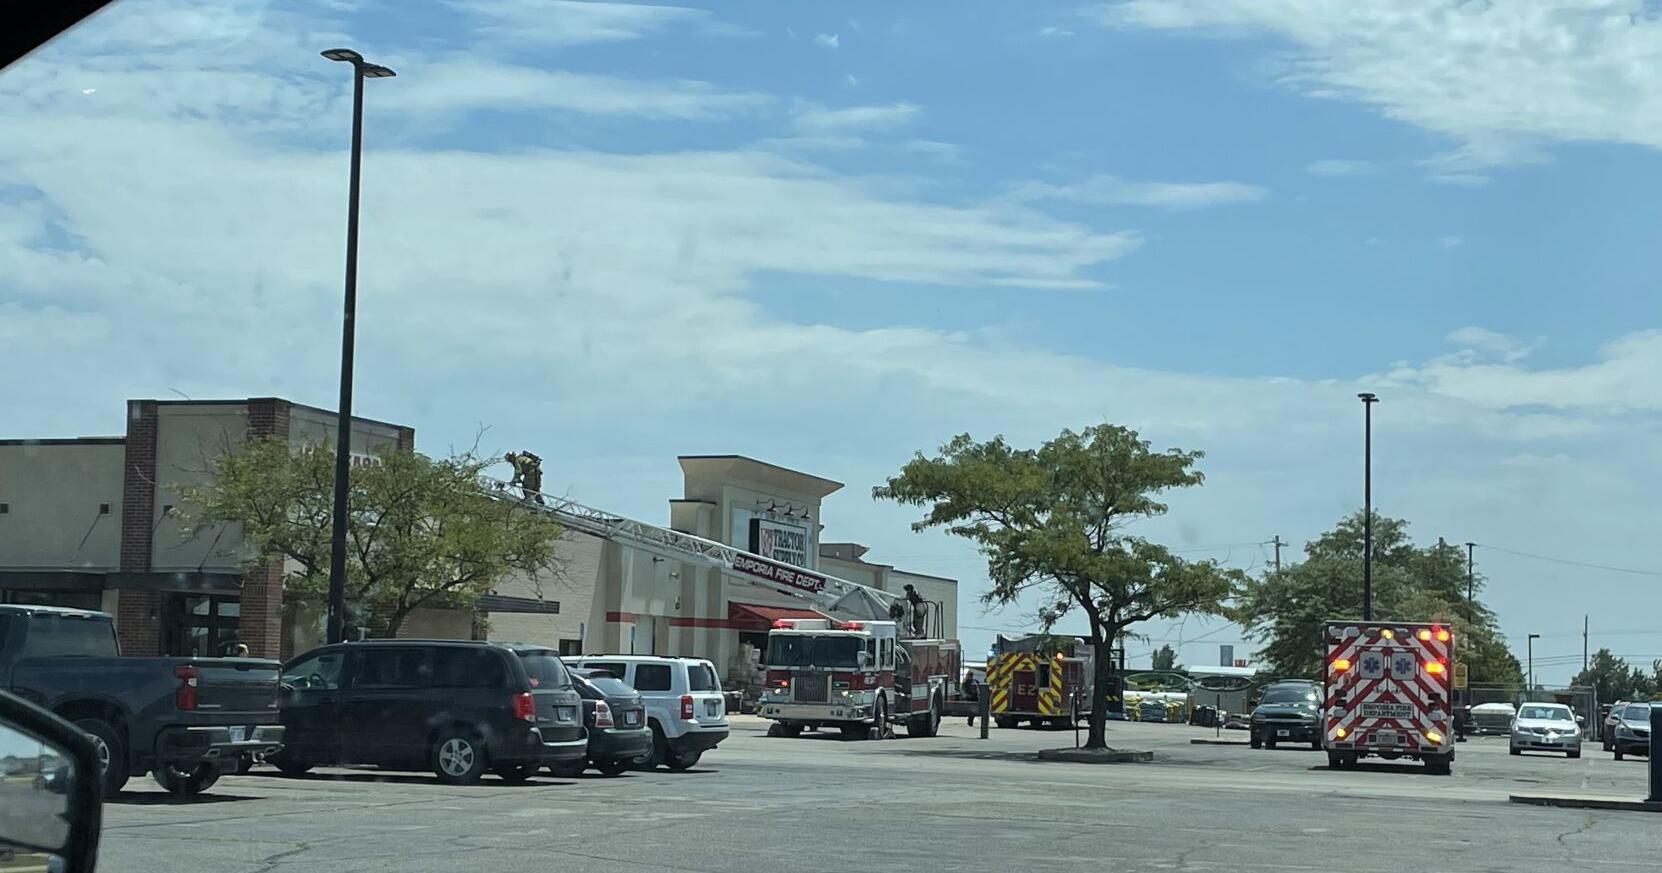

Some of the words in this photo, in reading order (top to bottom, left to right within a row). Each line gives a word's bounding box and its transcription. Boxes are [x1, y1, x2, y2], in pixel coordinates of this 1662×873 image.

[773, 529, 804, 552] TRACTOR
[735, 557, 773, 577] EMPORIA
[775, 568, 796, 583] FIRE
[1017, 684, 1037, 696] E2
[1363, 703, 1394, 711] EMPORIA
[1396, 704, 1412, 712] FIRE
[1363, 710, 1411, 718] DEPARTMENT
